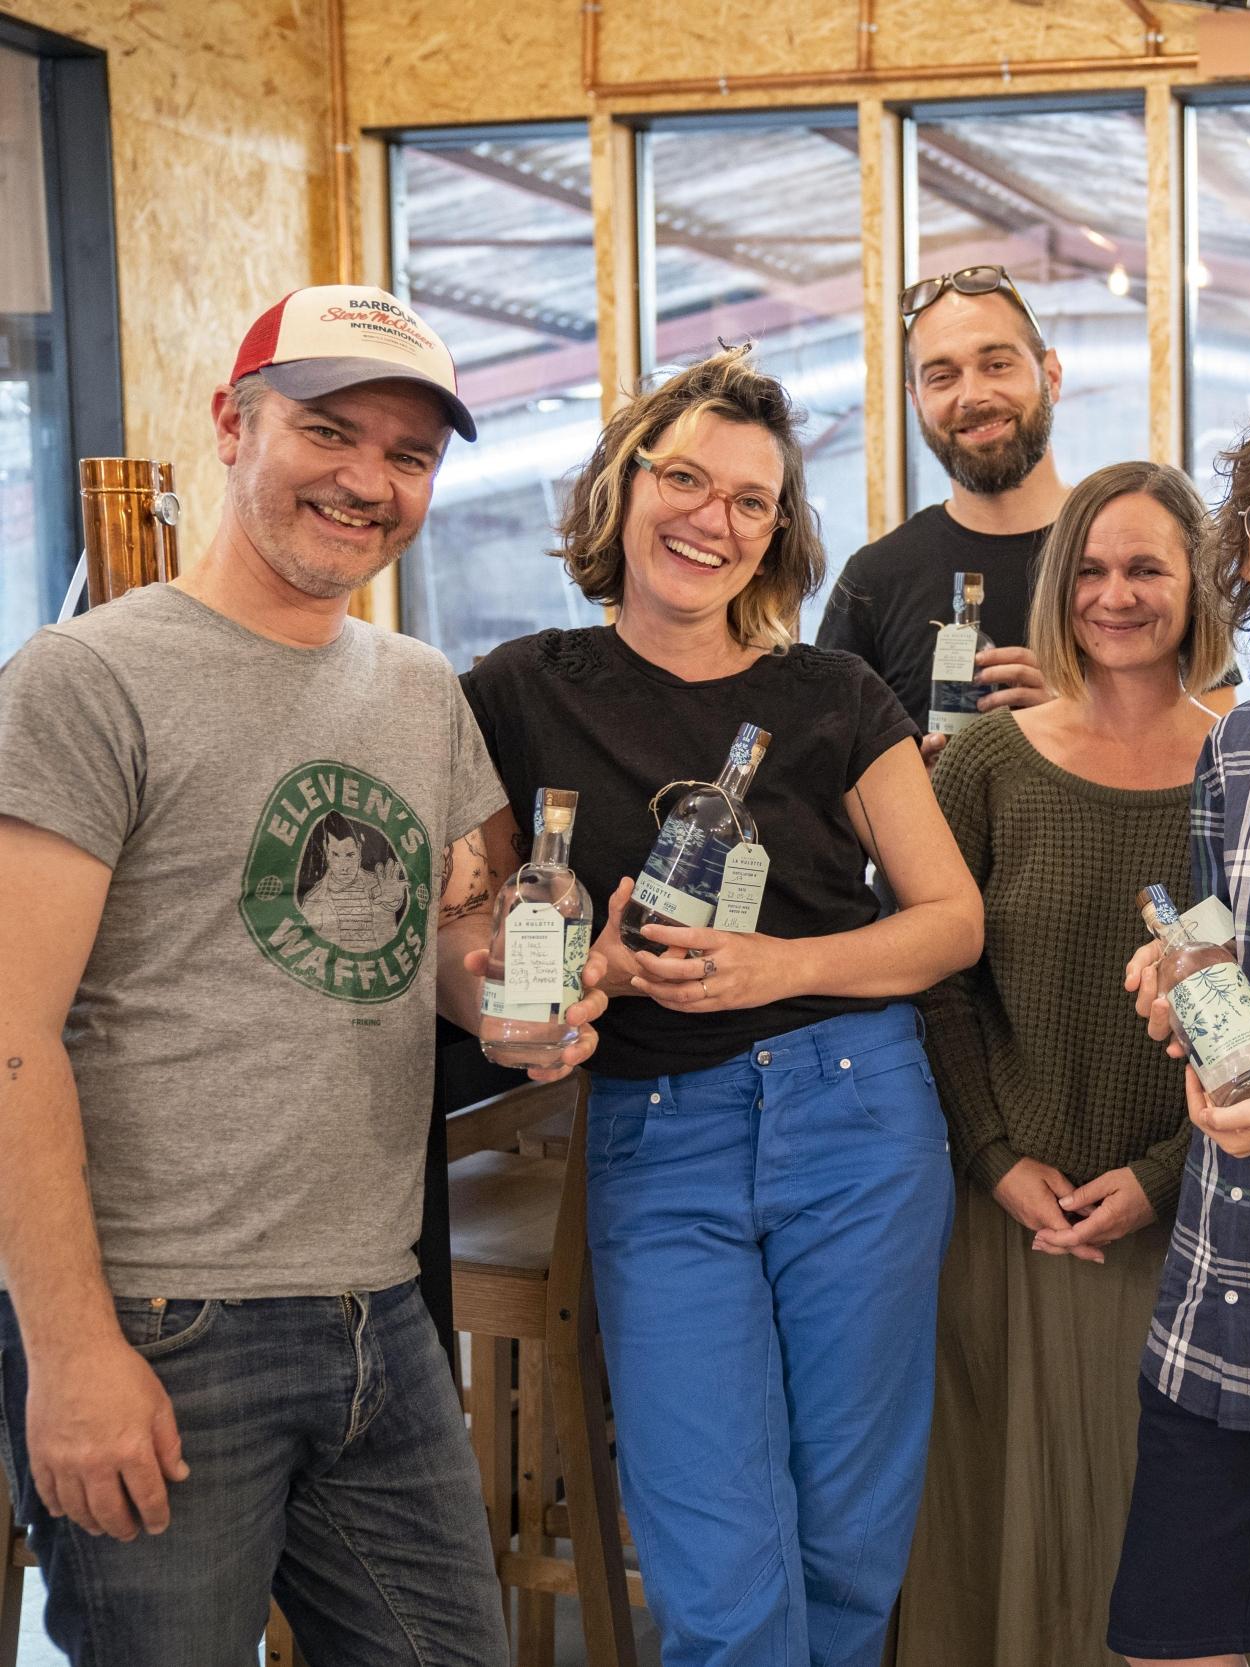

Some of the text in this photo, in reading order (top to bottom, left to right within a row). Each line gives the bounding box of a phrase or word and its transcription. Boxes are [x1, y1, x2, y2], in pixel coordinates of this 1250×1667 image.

[320, 307, 368, 322] Steve
[369, 311, 434, 349] McQueen
[350, 300, 418, 328] BARBOUR
[350, 322, 423, 349] INTERNATIONAL
[267, 774, 425, 854] ELEVEN'S
[640, 890, 658, 906] GIN
[646, 883, 671, 898] HULOTTE
[268, 918, 423, 990] WAFFLES
